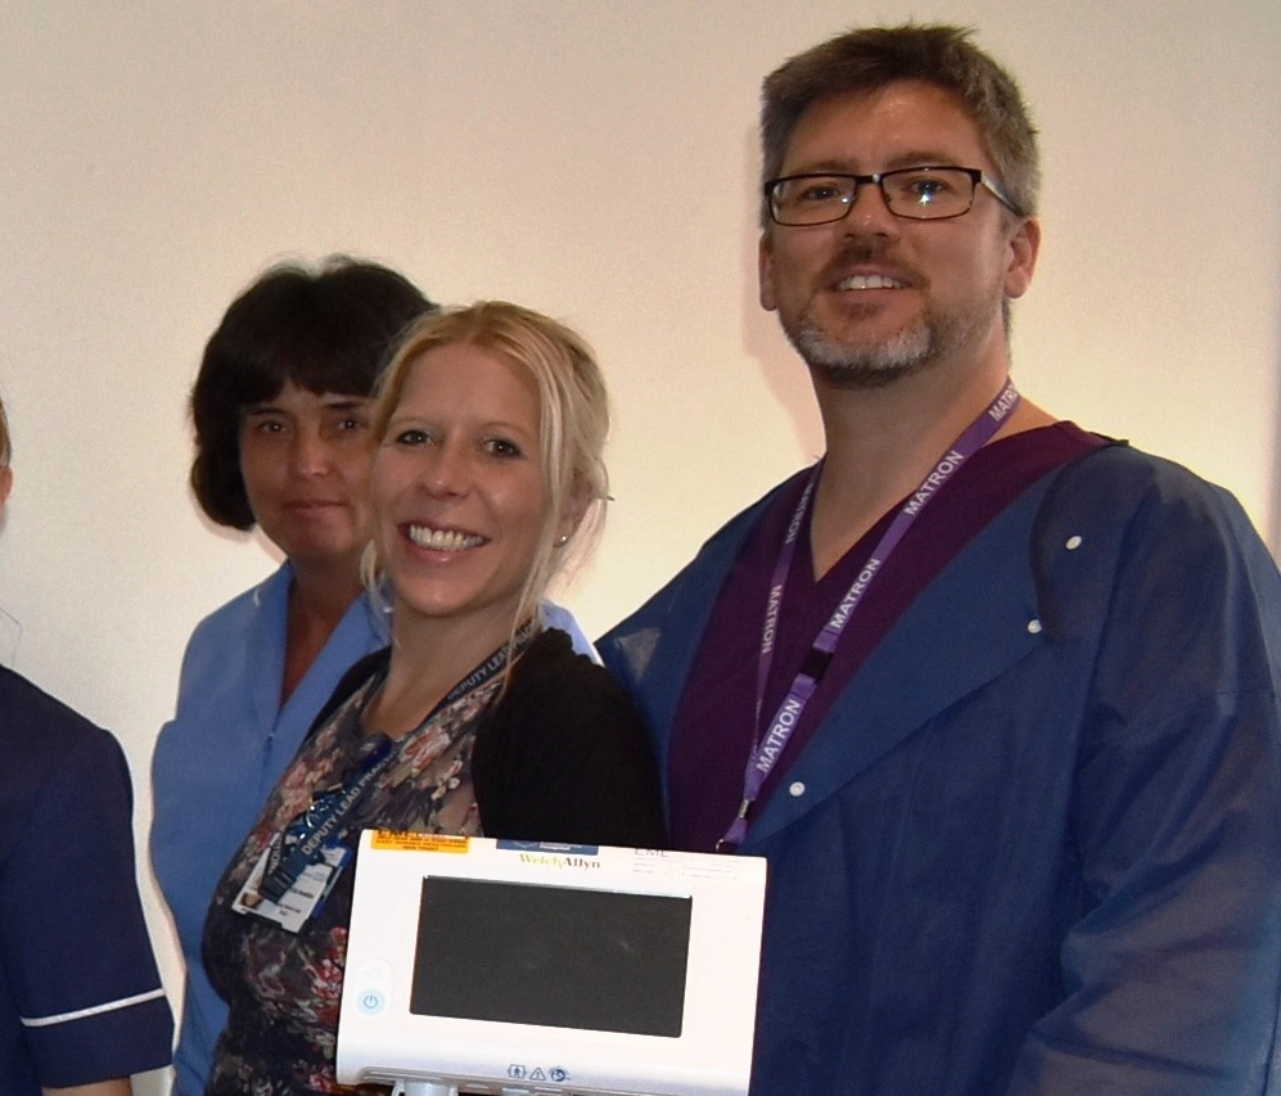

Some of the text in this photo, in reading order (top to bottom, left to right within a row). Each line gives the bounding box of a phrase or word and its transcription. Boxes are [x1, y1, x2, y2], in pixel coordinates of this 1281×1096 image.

[904, 450, 965, 516] MATRON
[830, 557, 881, 629] MATRON
[757, 699, 801, 774] MATRON
[301, 789, 361, 856] DEPUTY LEAD
[519, 853, 601, 869] WelchAllyn
